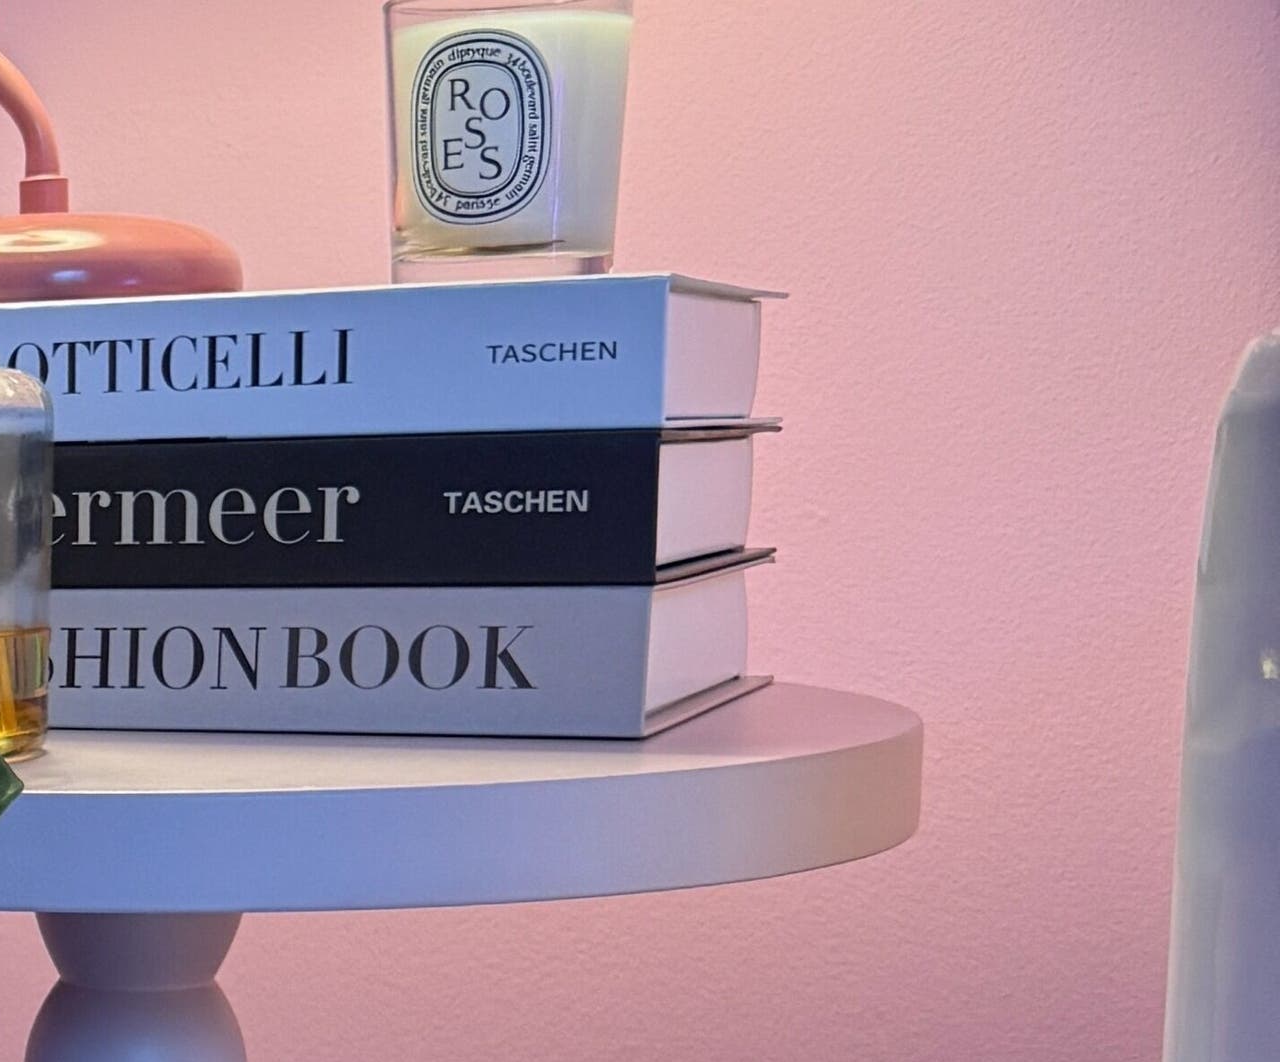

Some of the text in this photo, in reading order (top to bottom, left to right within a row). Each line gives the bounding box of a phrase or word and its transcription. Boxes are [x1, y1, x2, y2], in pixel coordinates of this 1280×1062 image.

[526, 122, 539, 152] saint
[486, 340, 618, 365] TASCHEN
[50, 484, 360, 546] rmeer
[443, 489, 589, 515] TASCHEN
[48, 624, 538, 691] HION BOOK
